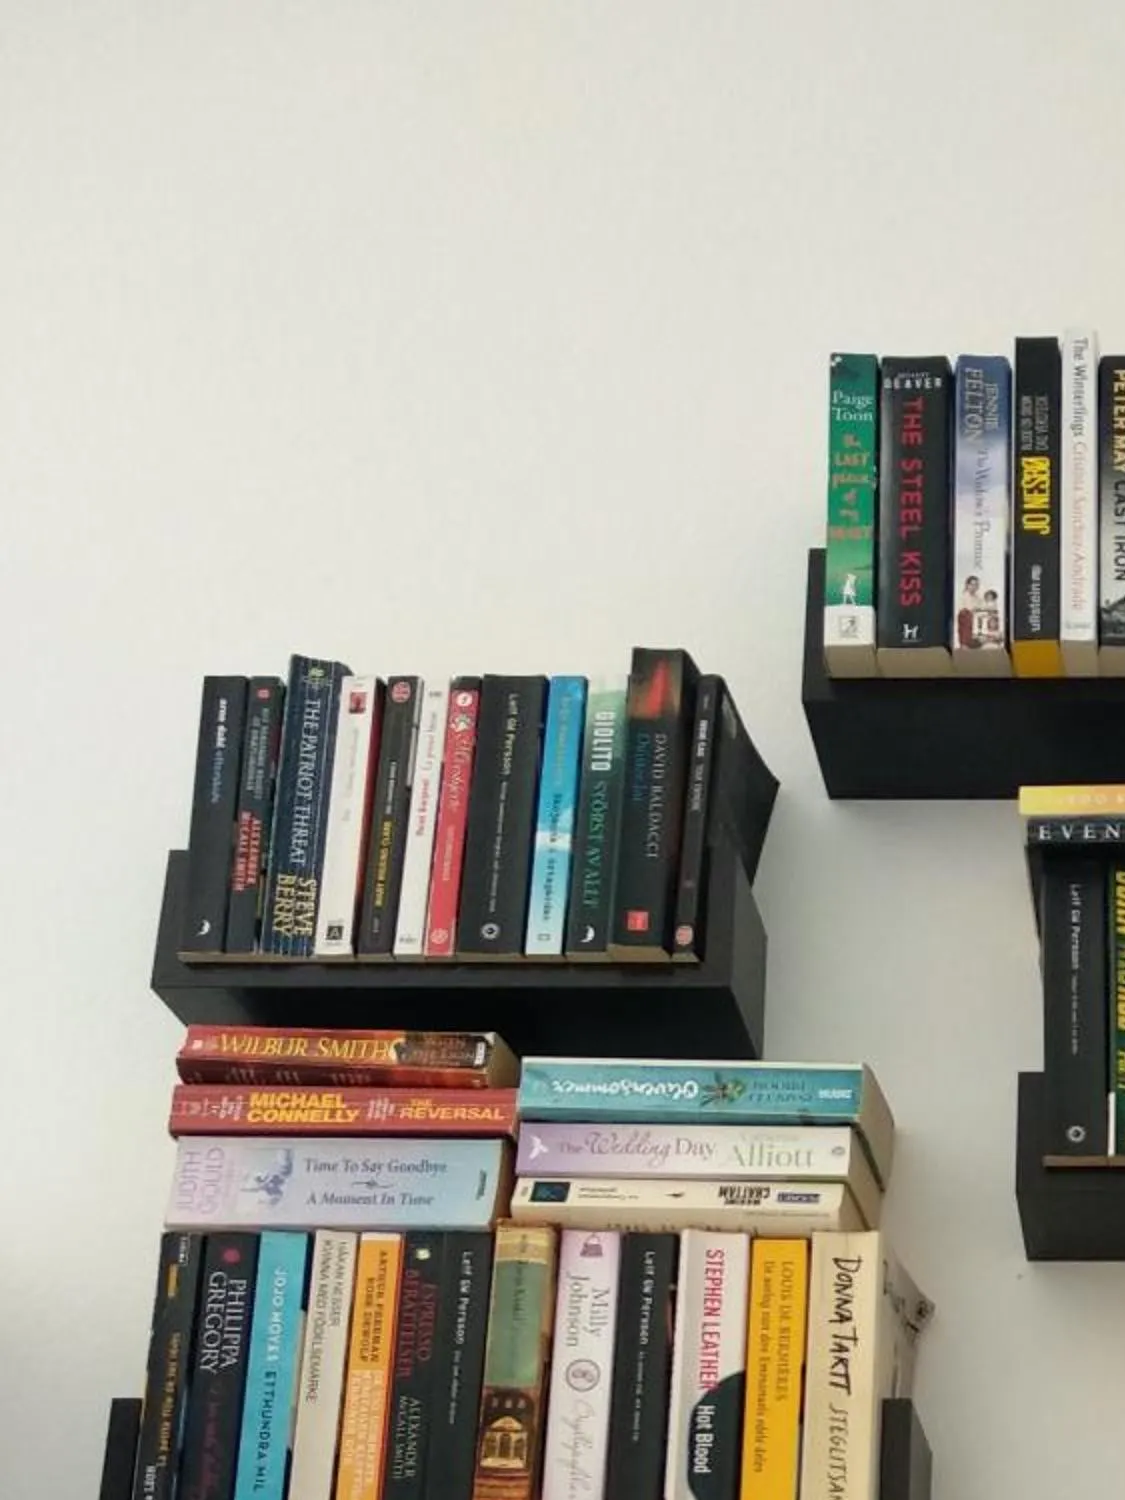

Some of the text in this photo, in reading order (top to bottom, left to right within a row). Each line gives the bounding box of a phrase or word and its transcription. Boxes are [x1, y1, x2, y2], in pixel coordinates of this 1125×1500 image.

[1072, 338, 1089, 360] The
[831, 390, 874, 406] Paige
[832, 407, 874, 421] Toon
[884, 378, 943, 389] DEAVER
[962, 366, 985, 442] FELTON
[900, 396, 924, 607] THE STEEL KISS
[1020, 514, 1051, 536] JO
[214, 725, 228, 749] dahl
[589, 712, 617, 771] GIOLITO
[288, 699, 323, 868] THE PATRIOT THREAT
[645, 733, 668, 859] DAVID BALDACCI
[271, 874, 296, 938] BERRY
[294, 876, 317, 937] STEVE
[219, 1034, 392, 1058] WILBUR SMITH
[247, 1108, 360, 1123] CONNELLY
[249, 1092, 348, 1110] MICHAEL
[400, 1105, 505, 1121] REVERSAL
[305, 1158, 448, 1177] Time To Say Goodbye
[199, 1272, 225, 1374] GREGORY
[221, 1280, 247, 1369] PHILIPPA
[265, 1268, 288, 1362] JOJO MOYES
[564, 1275, 591, 1348] Johnson
[586, 1289, 609, 1338] Milly
[699, 1249, 725, 1391] STEPHEN LEATHER
[827, 1257, 862, 1396] DONNA TARTT
[253, 1371, 278, 1493] ETTHUNDRA MIL
[693, 1405, 716, 1473] Hot Blood
